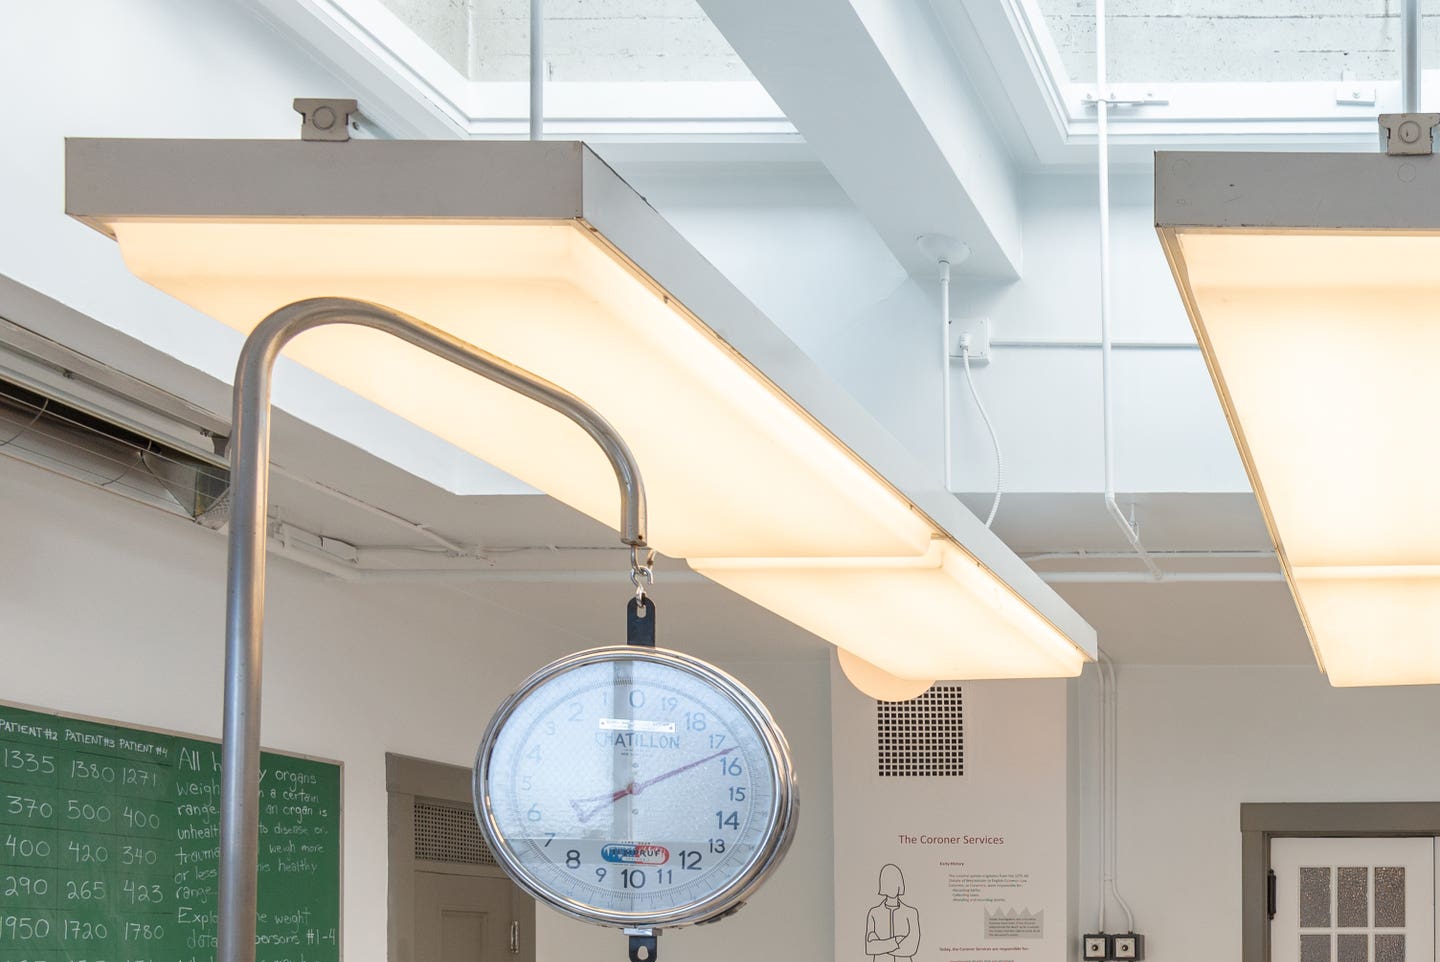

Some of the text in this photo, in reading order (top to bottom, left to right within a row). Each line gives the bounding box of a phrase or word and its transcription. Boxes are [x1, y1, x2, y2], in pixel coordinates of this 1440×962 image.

[602, 692, 607, 705] 1
[629, 690, 645, 708] 0
[662, 697, 678, 713] 19
[568, 702, 584, 722] 2
[0, 720, 42, 739] PATIENT
[546, 721, 556, 736] 3
[685, 712, 707, 732] 18
[119, 739, 154, 753] PATIENT
[596, 732, 680, 749] CHATILLON
[709, 733, 726, 749] 17
[526, 744, 543, 762] 4
[4, 748, 157, 787] 1335 1380 1271
[179, 747, 200, 771] All
[274, 769, 318, 793] organs
[720, 757, 743, 776] 16
[521, 776, 532, 791] 5
[270, 788, 278, 799] a
[283, 788, 320, 803] certain
[729, 787, 746, 802] 15
[7, 795, 160, 830] 370 500 400
[266, 803, 279, 816] an
[283, 805, 314, 825] organ
[320, 809, 328, 818] is
[527, 803, 541, 822] 6
[715, 811, 740, 831] 14
[178, 824, 221, 840] unhealt
[544, 832, 556, 847] 7
[899, 835, 1004, 845] The Coroner Services
[6, 834, 157, 865] 400 420 340
[709, 838, 726, 853] 13
[175, 847, 220, 866] trauma
[301, 845, 323, 853] more
[566, 850, 581, 869] 8
[678, 851, 703, 871] 12
[174, 869, 190, 885] or
[195, 865, 218, 880] less
[279, 858, 318, 876] healthy
[595, 867, 607, 882] 9
[621, 868, 646, 889] 10
[657, 868, 673, 884] 11
[5, 875, 164, 905] 290 265 423
[64, 919, 108, 941] 1720
[124, 921, 165, 941] 1780
[178, 907, 218, 931] Explo
[274, 906, 312, 935] weight
[186, 928, 218, 949] data
